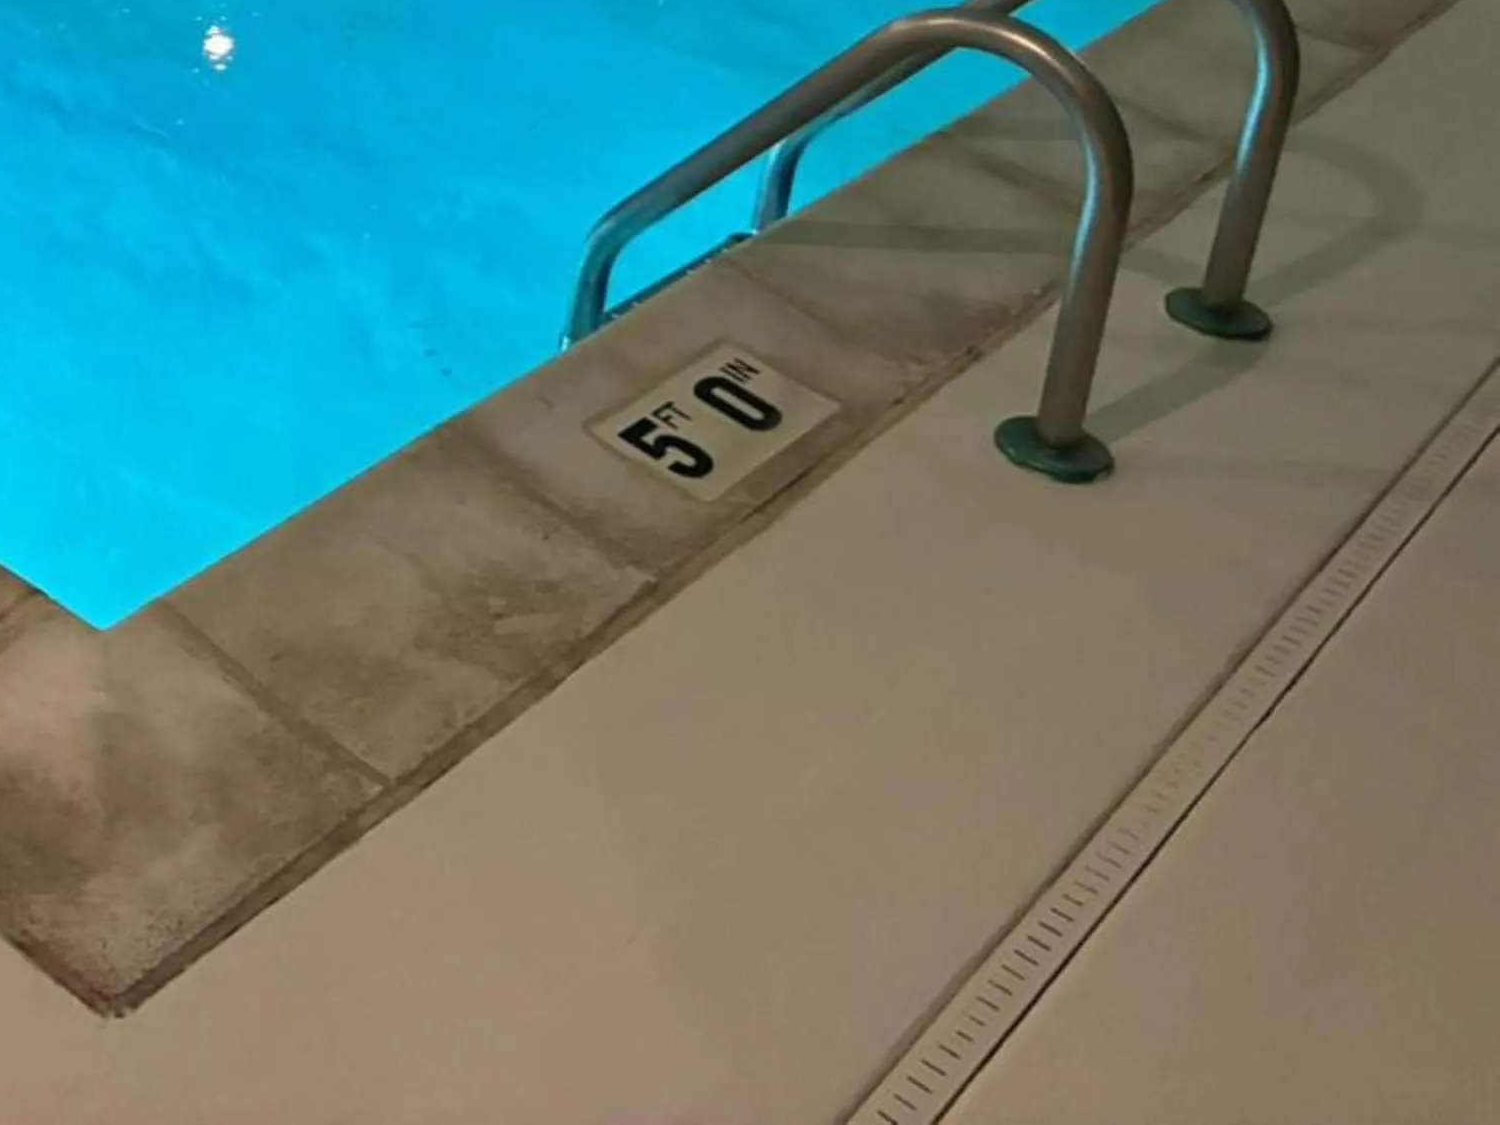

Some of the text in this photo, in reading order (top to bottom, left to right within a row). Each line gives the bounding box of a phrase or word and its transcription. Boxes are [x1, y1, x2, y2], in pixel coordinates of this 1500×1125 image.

[617, 357, 782, 479] 5 FT 0 IN
